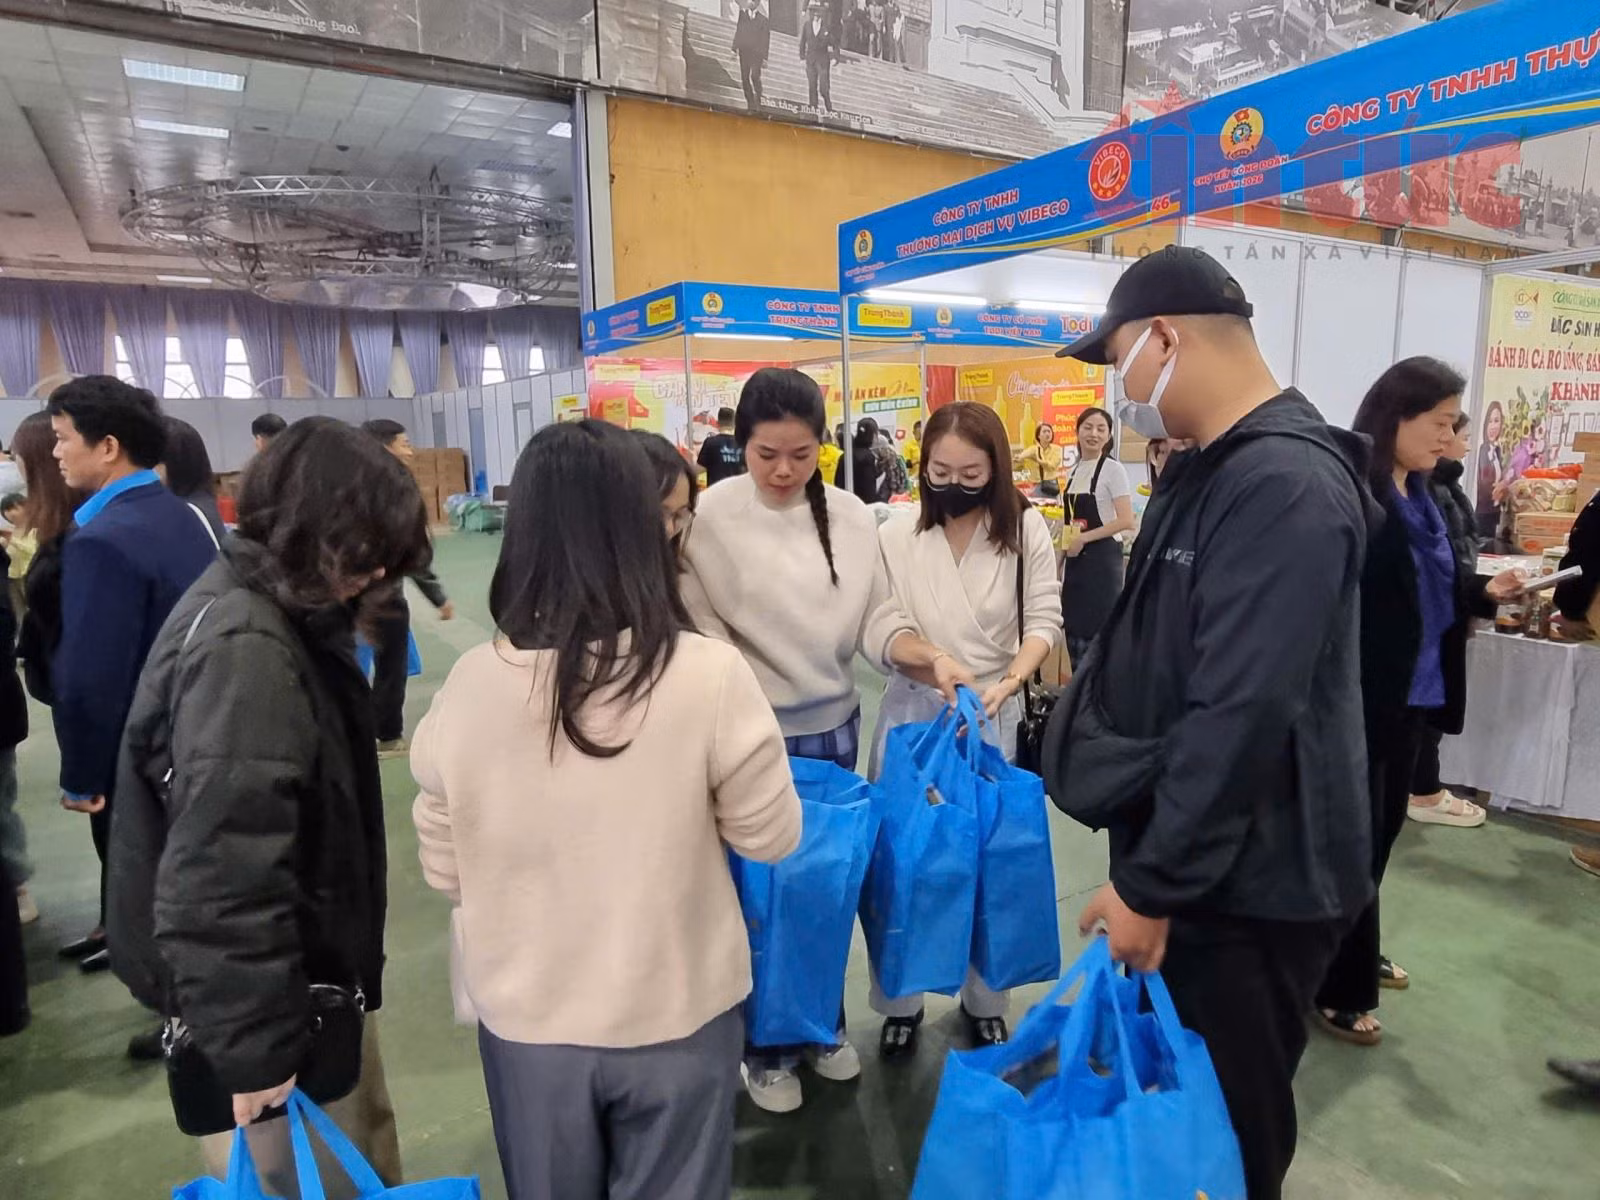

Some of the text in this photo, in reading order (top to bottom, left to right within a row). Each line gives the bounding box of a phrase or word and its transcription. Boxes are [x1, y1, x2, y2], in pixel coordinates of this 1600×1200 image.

[1306, 97, 1380, 136] CÔNG
[1386, 84, 1425, 113] TY
[1429, 57, 1518, 102] TNHH
[1094, 145, 1126, 166] VIBECO
[933, 188, 1020, 226] CÔNG TY TNHH
[1151, 195, 1170, 212] 46
[896, 236, 939, 258] THƯƠNG
[941, 233, 964, 248] MẠI
[965, 220, 995, 242] DỊCH
[996, 214, 1017, 233] VỤ
[1018, 198, 1071, 226] VIBECO
[766, 298, 796, 312] CÔNG
